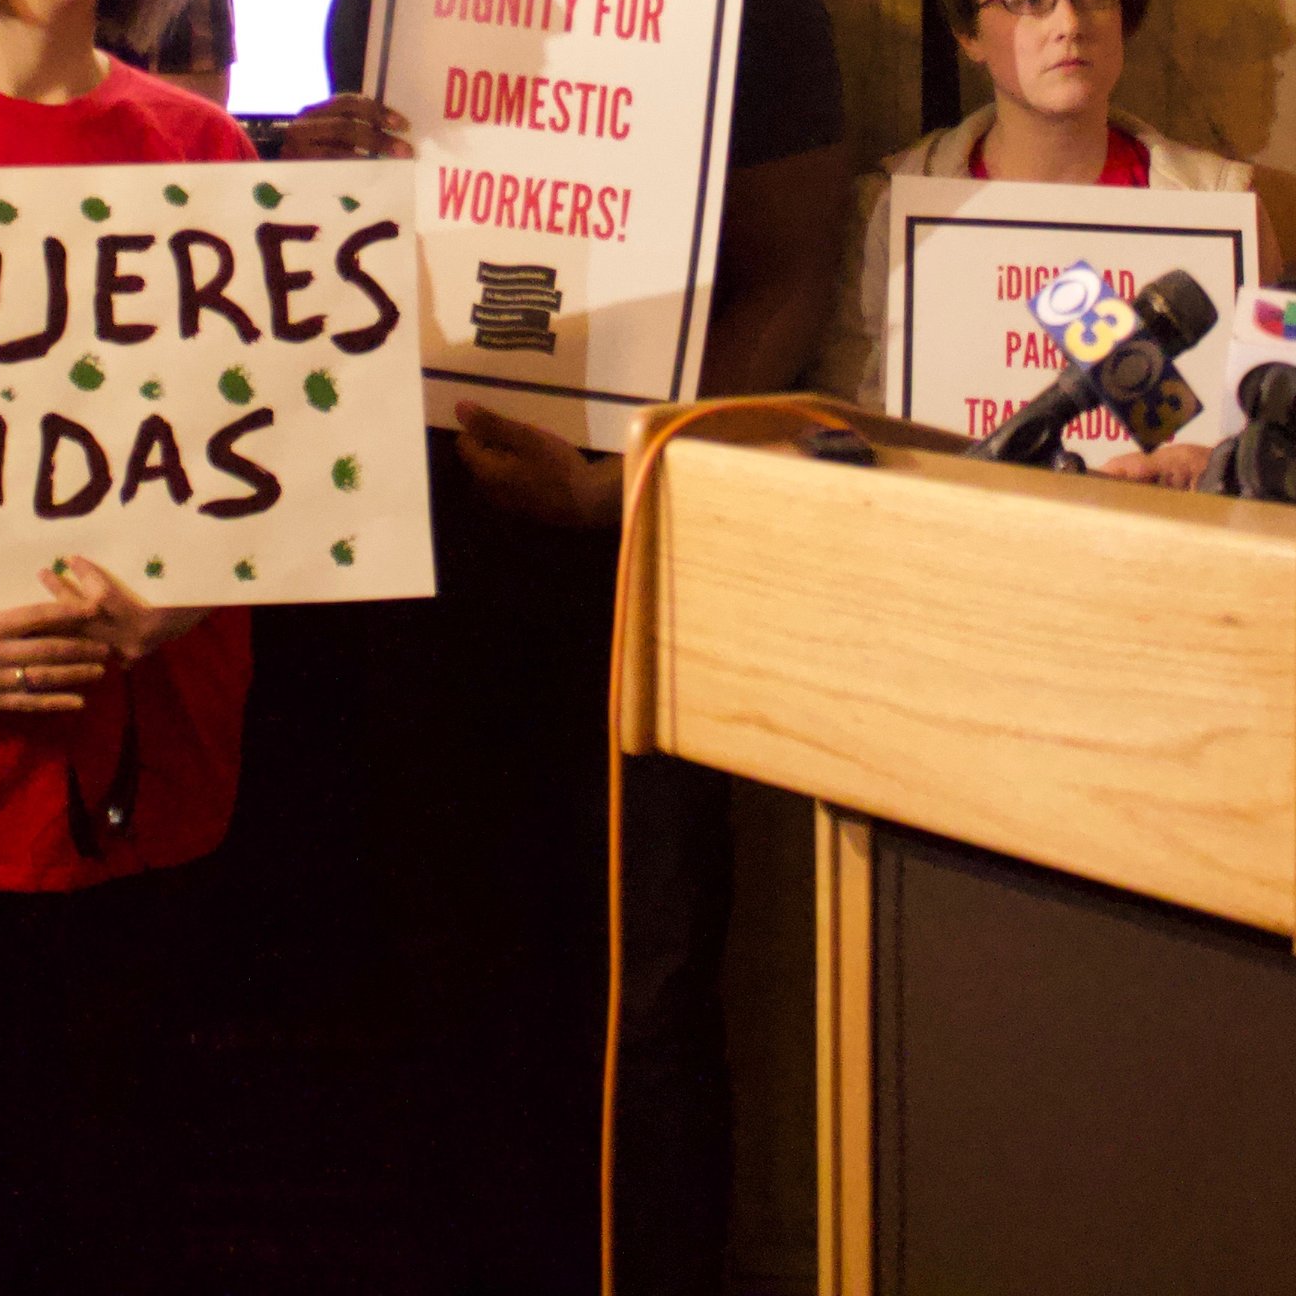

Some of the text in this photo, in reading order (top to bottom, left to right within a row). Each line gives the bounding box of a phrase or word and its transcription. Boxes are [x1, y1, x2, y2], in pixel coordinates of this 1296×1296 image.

[443, 66, 634, 141] DOMESTIC
[437, 166, 632, 243] WORKERS!
[1006, 331, 1068, 369] PAR
[1064, 297, 1137, 363] 3
